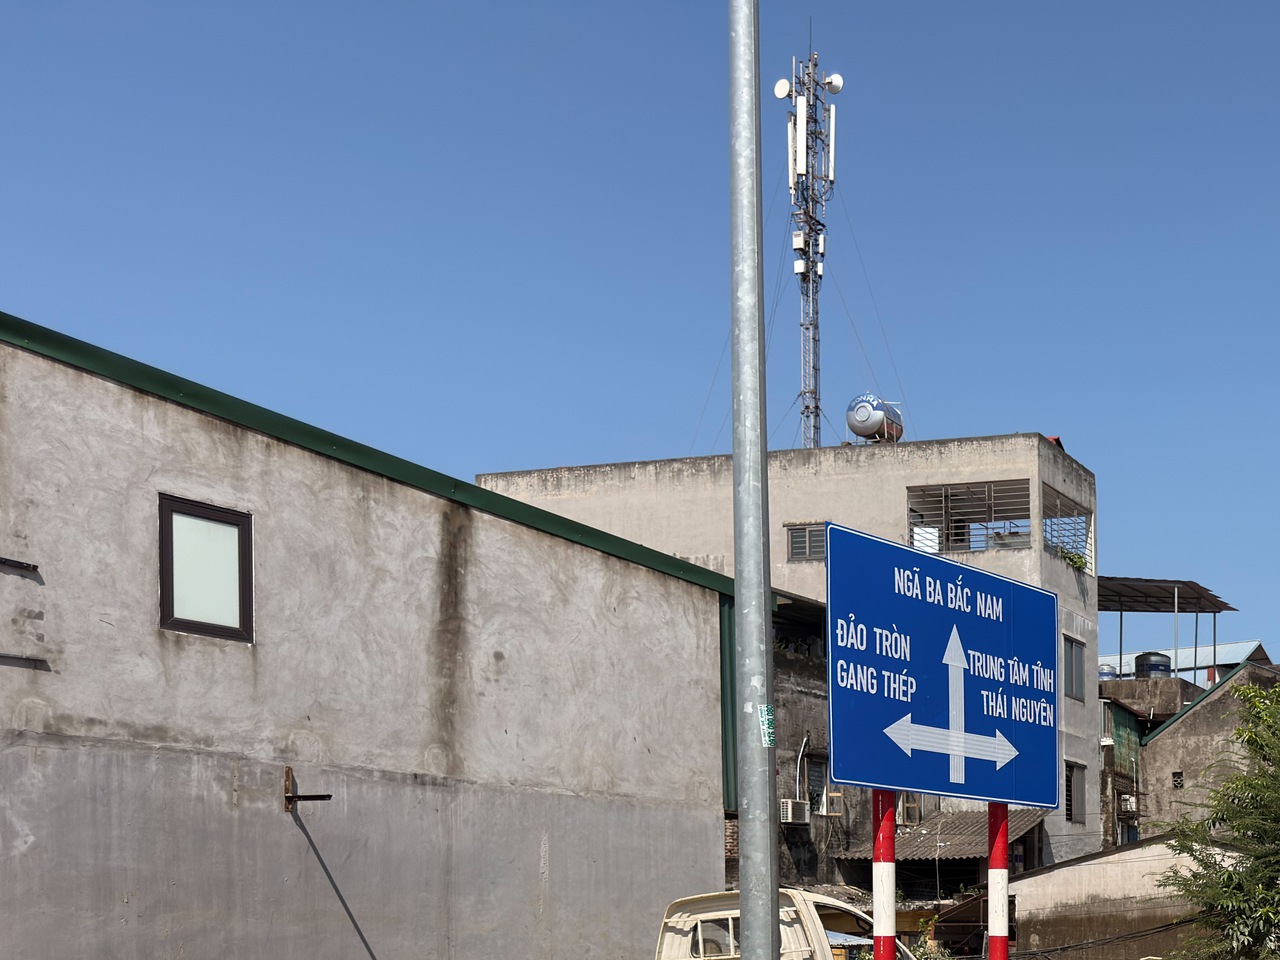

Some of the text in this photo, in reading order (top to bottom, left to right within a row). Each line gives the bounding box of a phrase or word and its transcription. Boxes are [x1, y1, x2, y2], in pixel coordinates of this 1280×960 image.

[894, 566, 1003, 622] NGÃ BA BẮC NAM
[836, 613, 911, 662] ĐẢO TRÒN
[837, 659, 917, 703] GANG THÉP
[967, 649, 1054, 693] TRUNG TÂM TỈNH
[981, 687, 1054, 728] THÁI NGUYÊN
